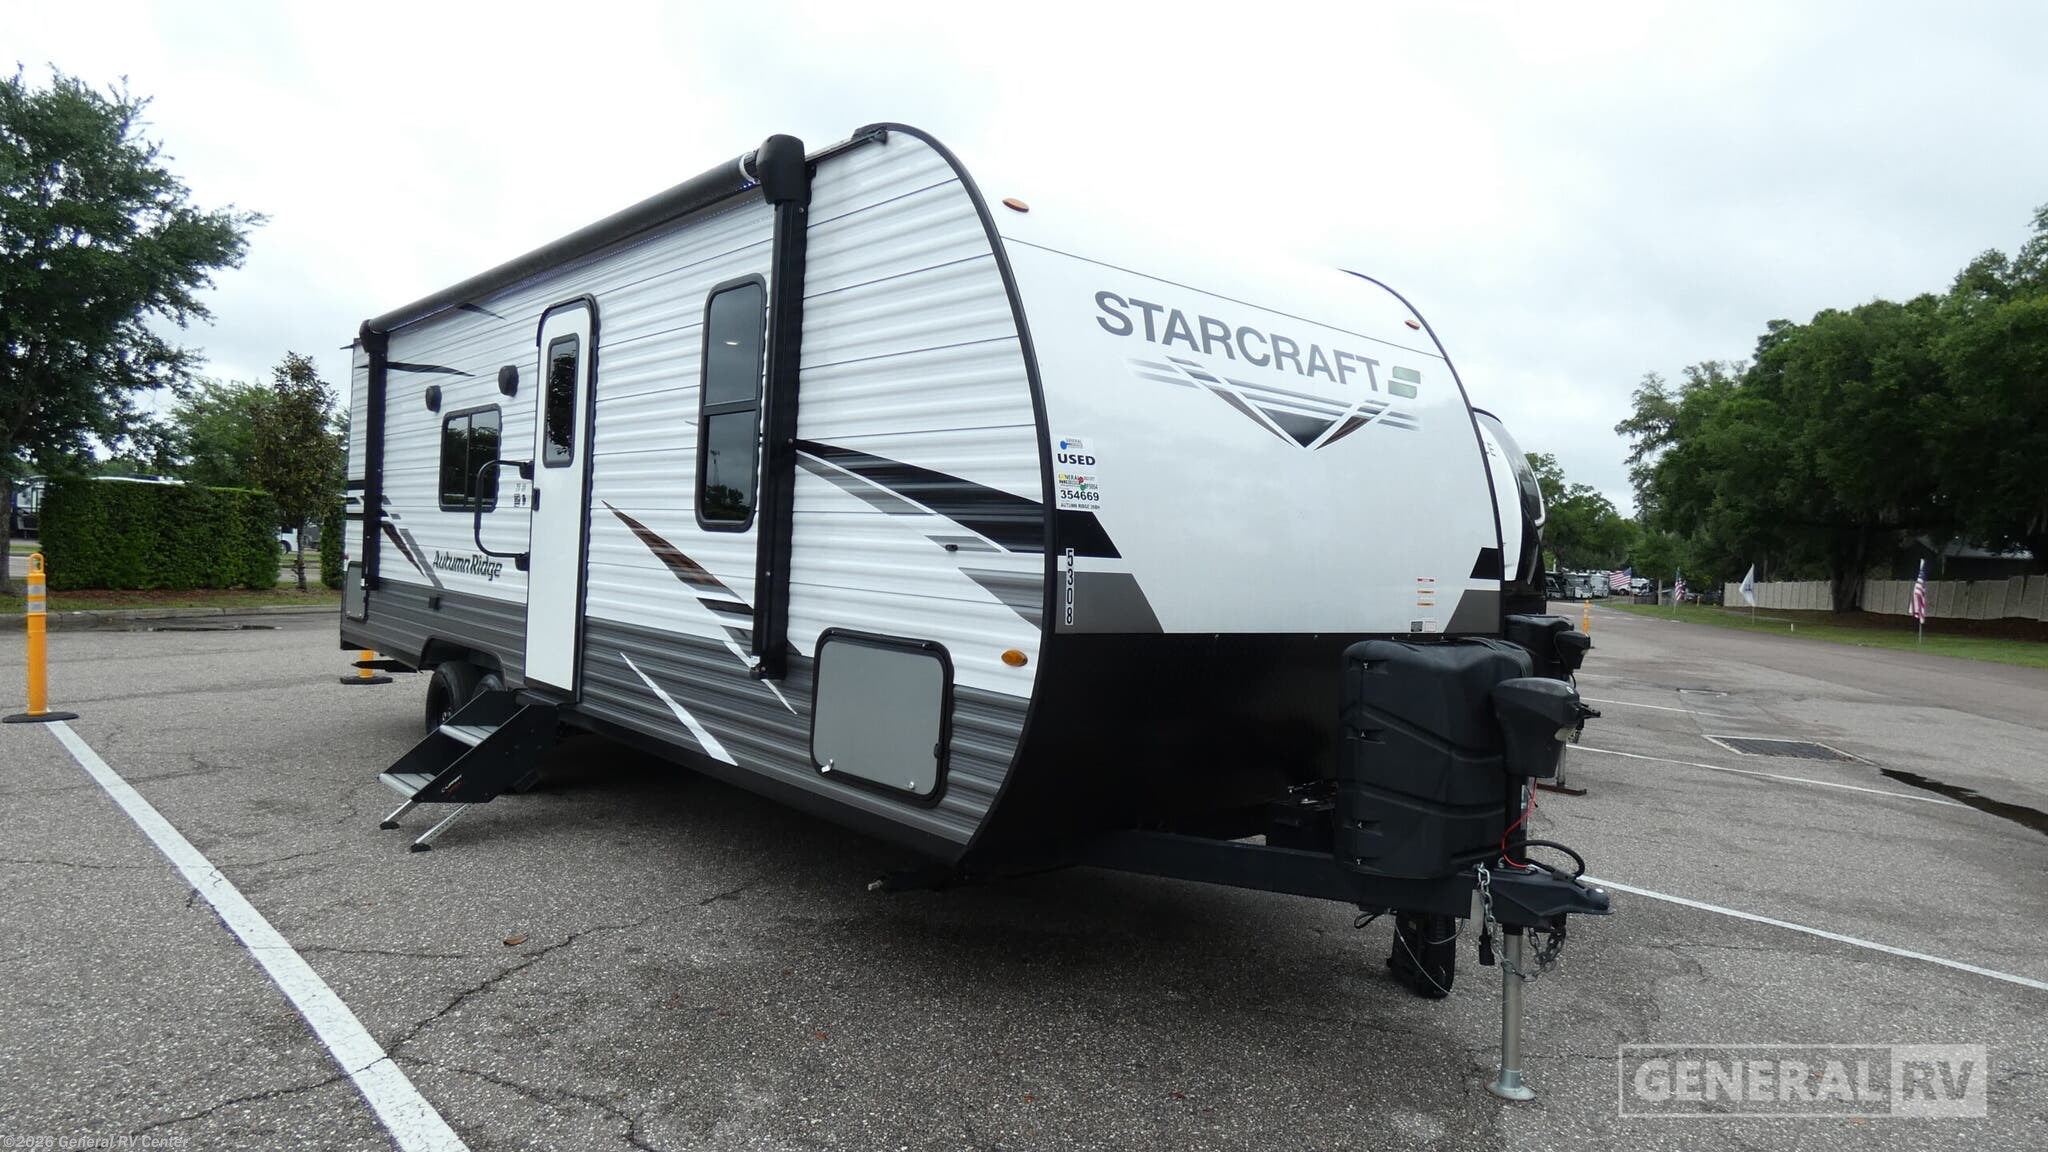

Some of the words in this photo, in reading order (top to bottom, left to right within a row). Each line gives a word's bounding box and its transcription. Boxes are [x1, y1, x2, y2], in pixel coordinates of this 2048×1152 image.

[1094, 290, 1381, 392] STARCRAFT
[1057, 453, 1096, 466] USED
[1060, 489, 1100, 502] 354669
[1066, 549, 1074, 624] 5308
